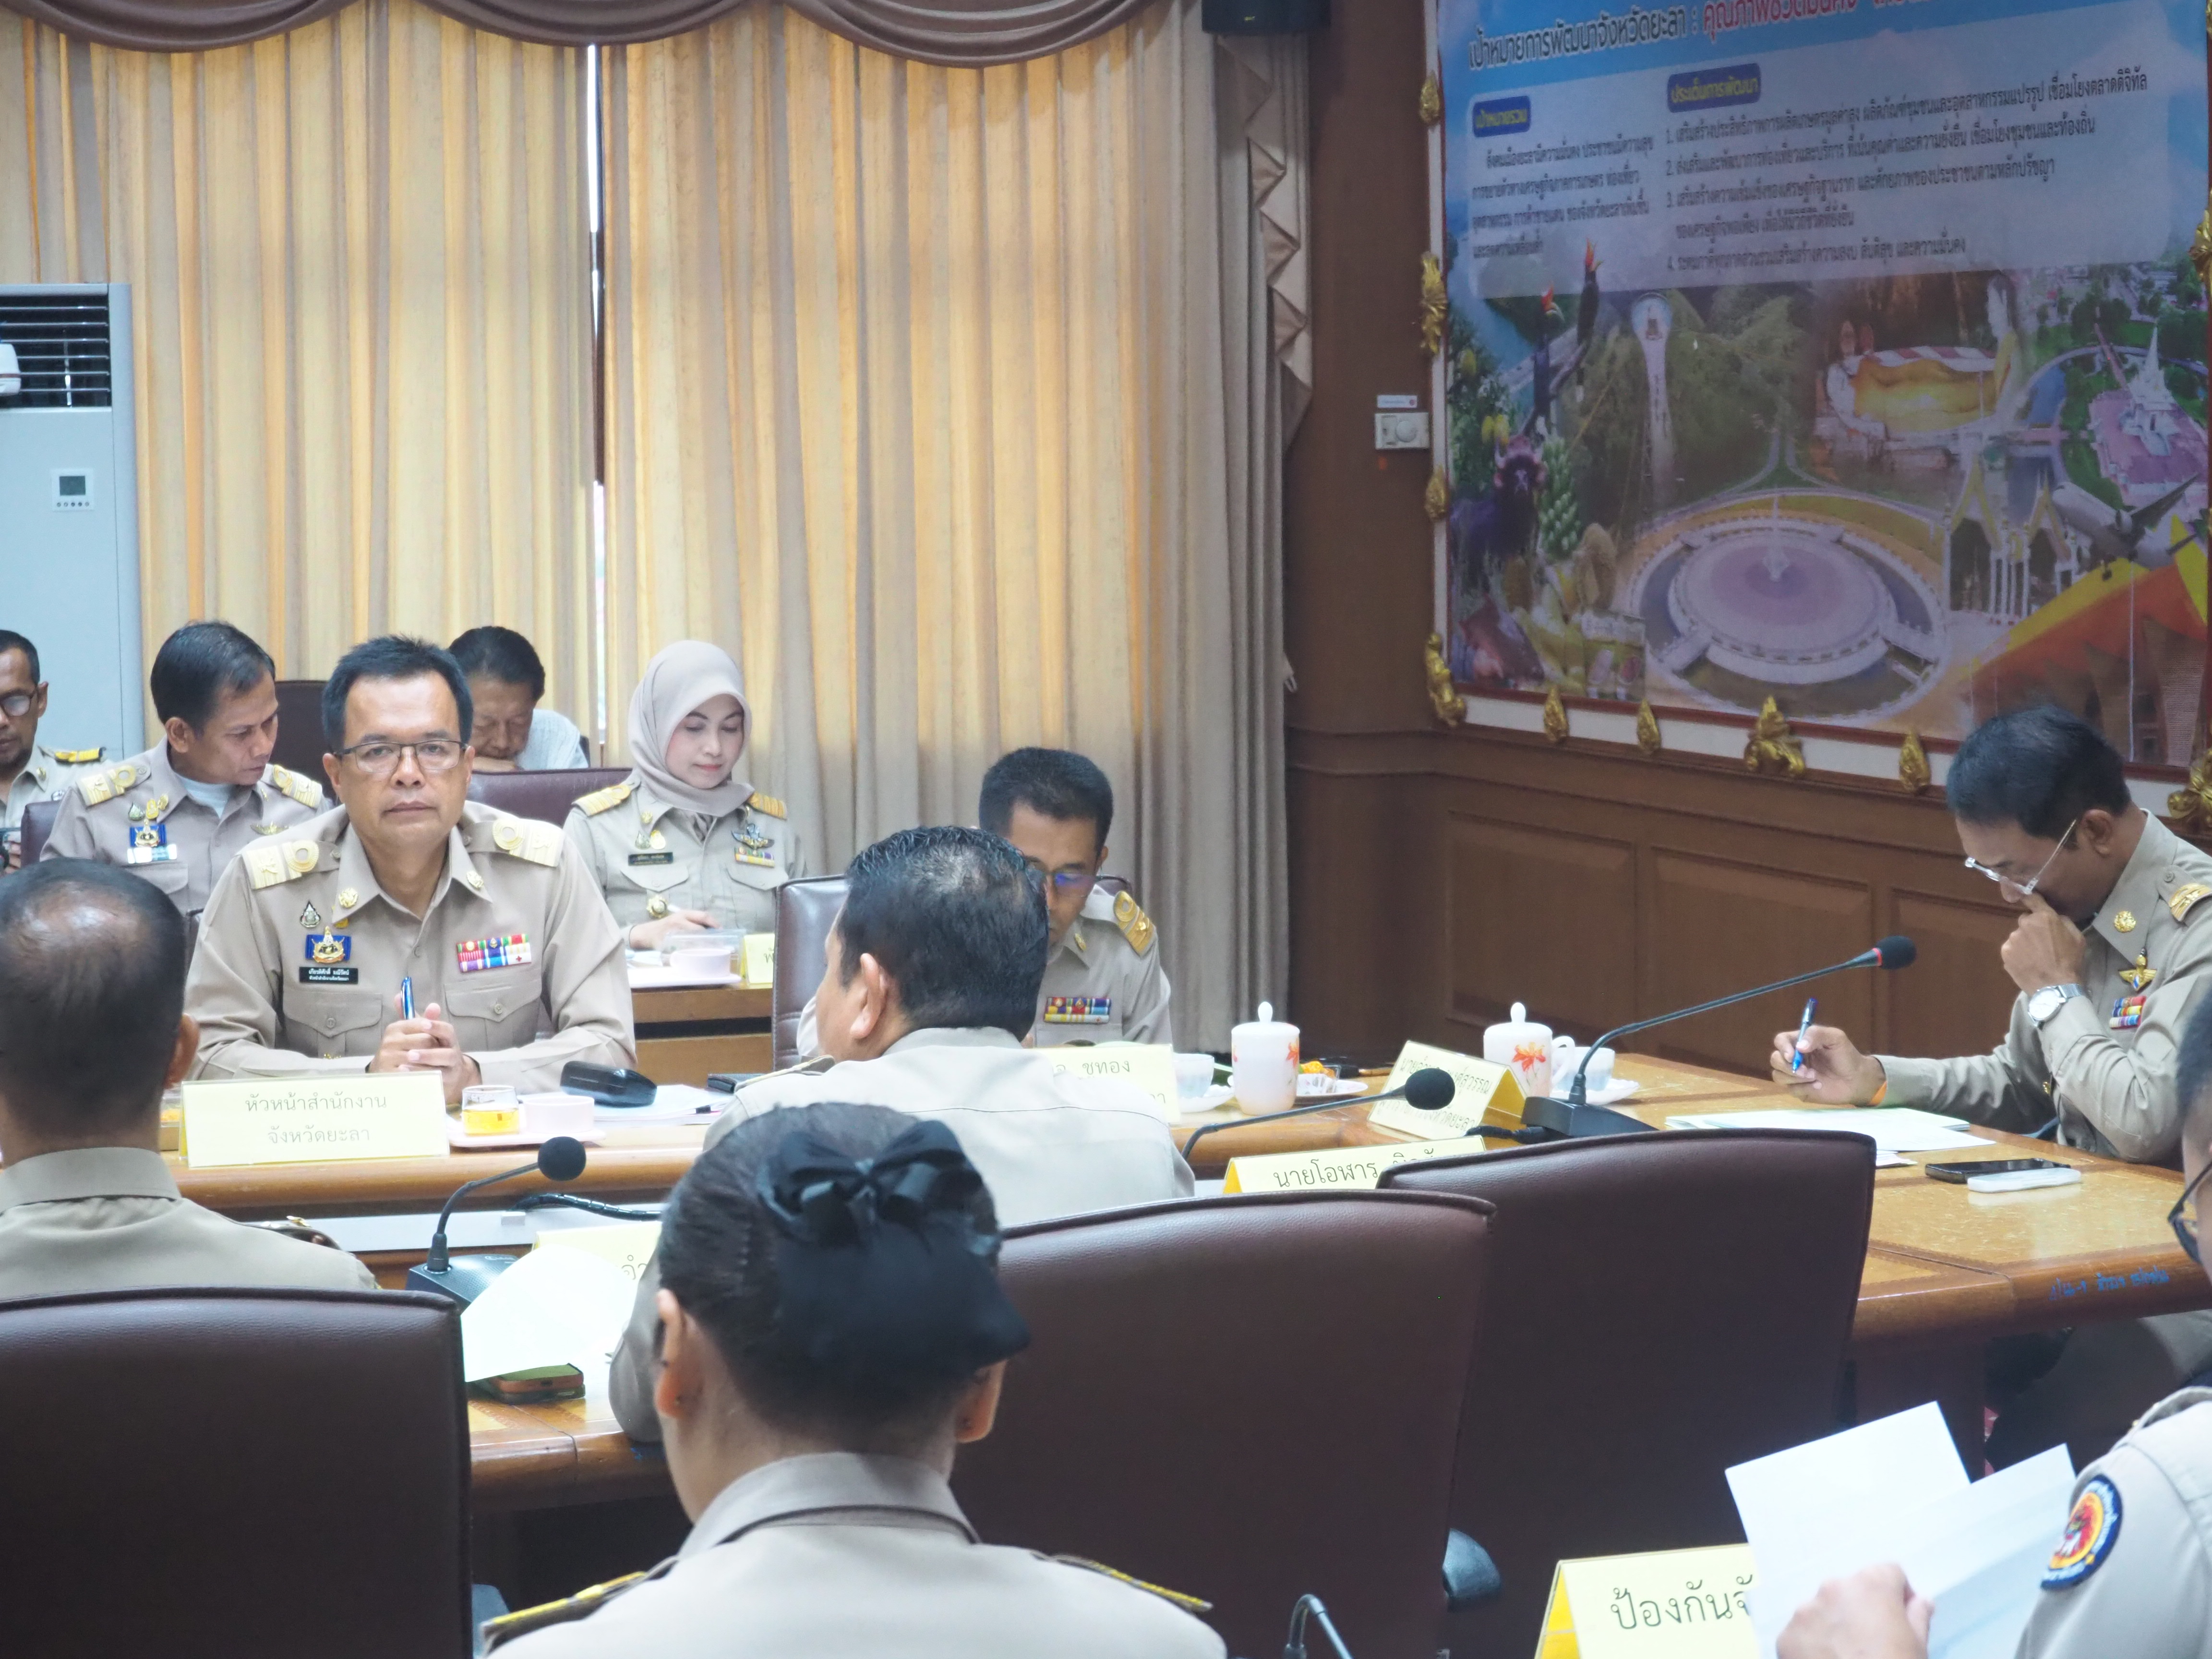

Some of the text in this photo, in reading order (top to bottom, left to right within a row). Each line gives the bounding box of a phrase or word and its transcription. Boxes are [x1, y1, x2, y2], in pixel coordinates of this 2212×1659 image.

[1469, 7, 1685, 69] เป้าหมายการพัฒนาจังหวัดยะลา
[1082, 1060, 1130, 1078] ชทอง
[245, 1091, 387, 1112] หัวหน้าสำนักงาน
[267, 1125, 370, 1143] จังหวัดยะลา
[1273, 1159, 1378, 1188] นายโอฬาร
